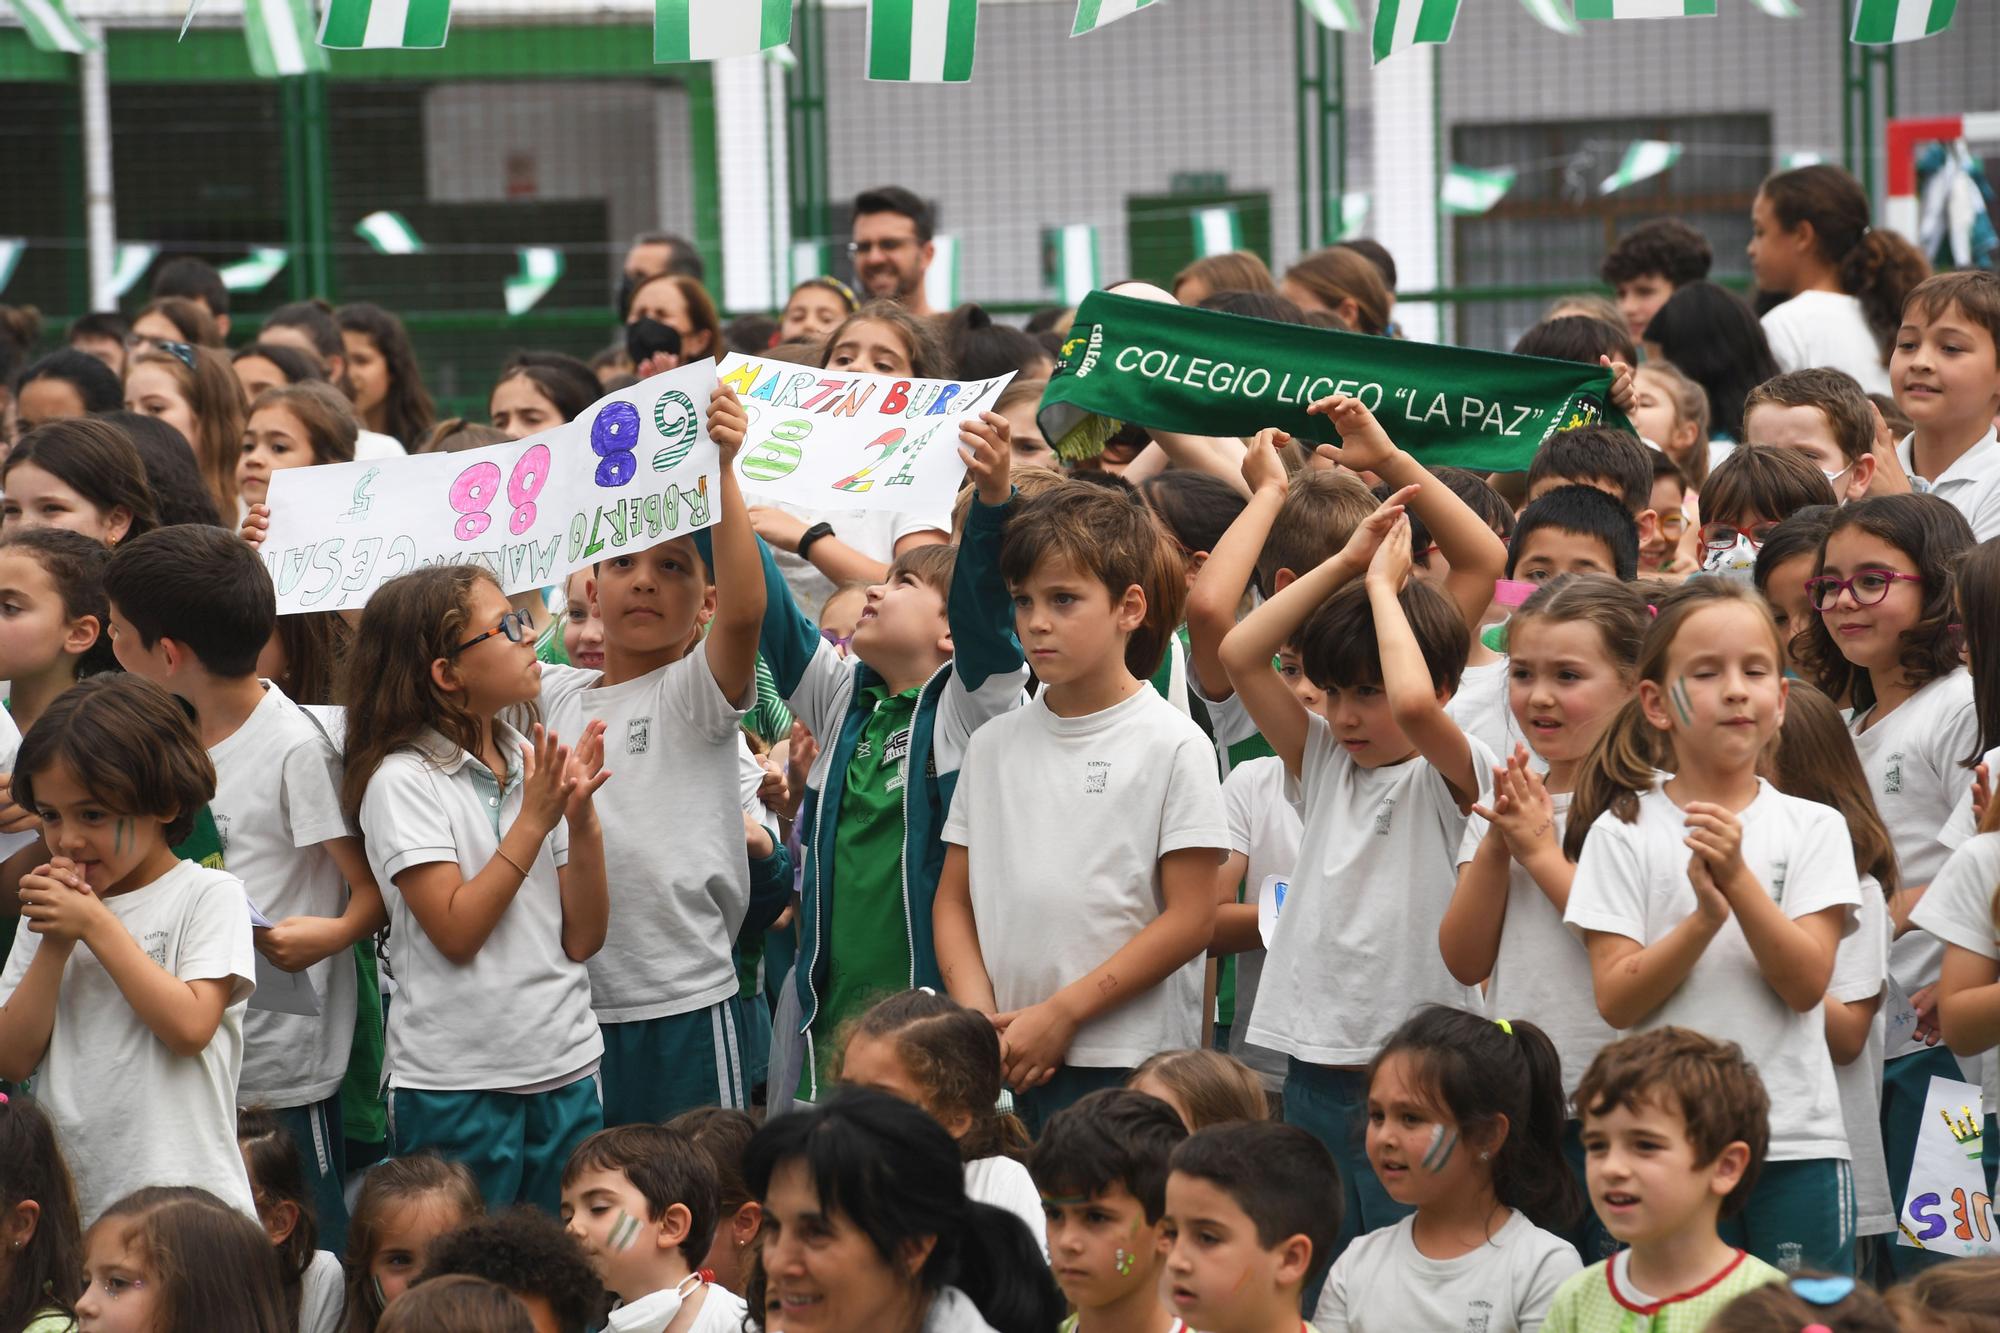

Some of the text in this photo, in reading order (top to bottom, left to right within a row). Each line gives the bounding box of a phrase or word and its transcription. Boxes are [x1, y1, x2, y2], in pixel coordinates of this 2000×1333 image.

[1115, 346, 1271, 397] COLEGIO
[1277, 373, 1384, 412] LICEO
[449, 443, 551, 542] 88
[832, 420, 944, 492] 21
[568, 475, 711, 564] ROBERTO
